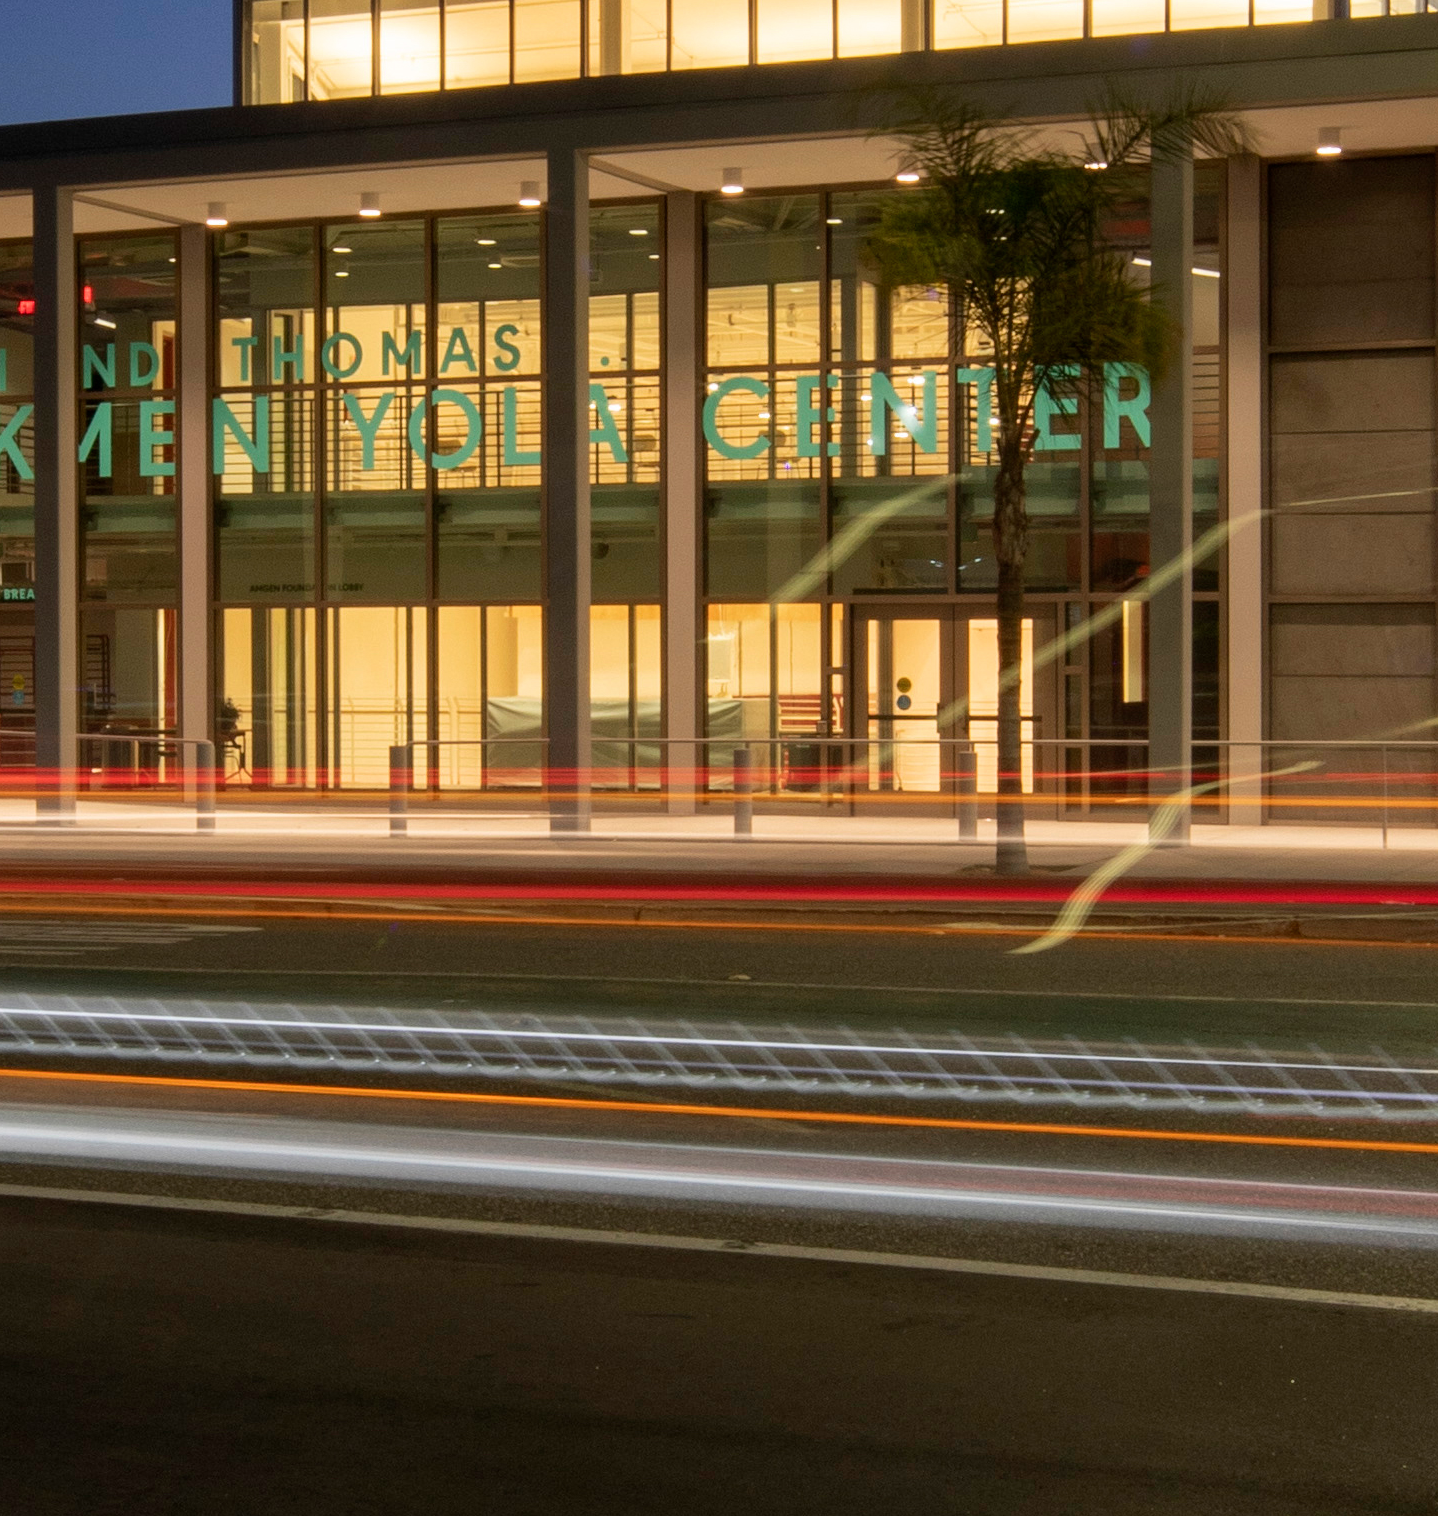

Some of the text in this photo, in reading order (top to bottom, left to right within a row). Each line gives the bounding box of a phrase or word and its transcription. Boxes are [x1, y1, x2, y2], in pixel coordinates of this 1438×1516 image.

[83, 341, 161, 389] ND
[232, 323, 521, 381] THOMAS
[342, 383, 630, 471] YOLA
[702, 361, 1152, 460] CENTER
[3, 588, 36, 601] BREA
